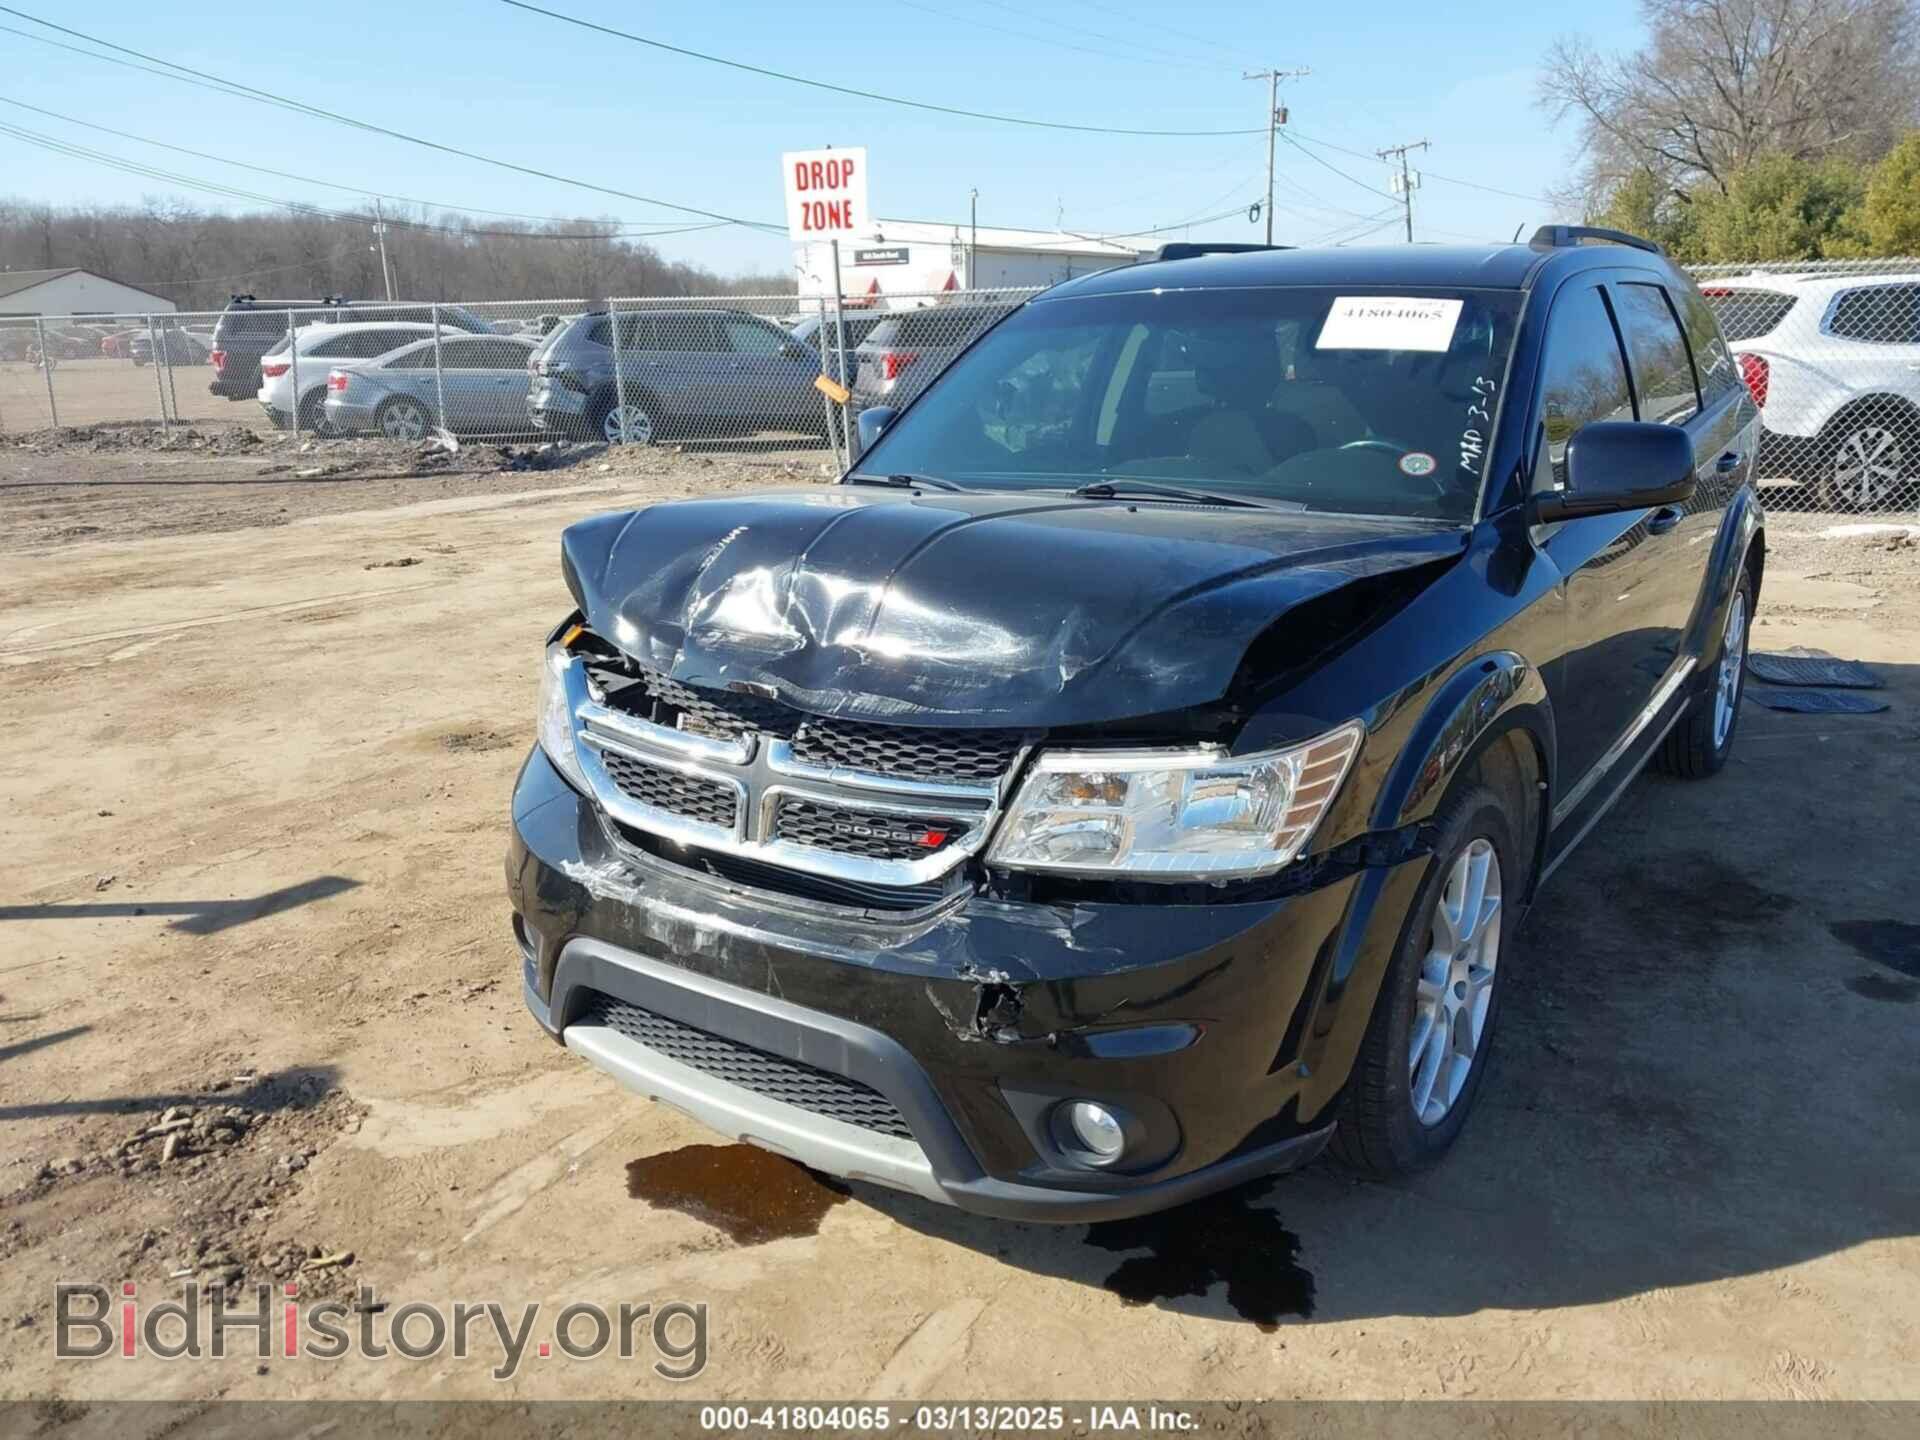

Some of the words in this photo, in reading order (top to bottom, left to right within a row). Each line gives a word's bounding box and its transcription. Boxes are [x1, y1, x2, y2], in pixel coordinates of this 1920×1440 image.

[794, 159, 855, 191] DROP
[801, 199, 854, 231] ZONE
[1343, 308, 1443, 320] 41804065
[835, 822, 924, 842] DODGE
